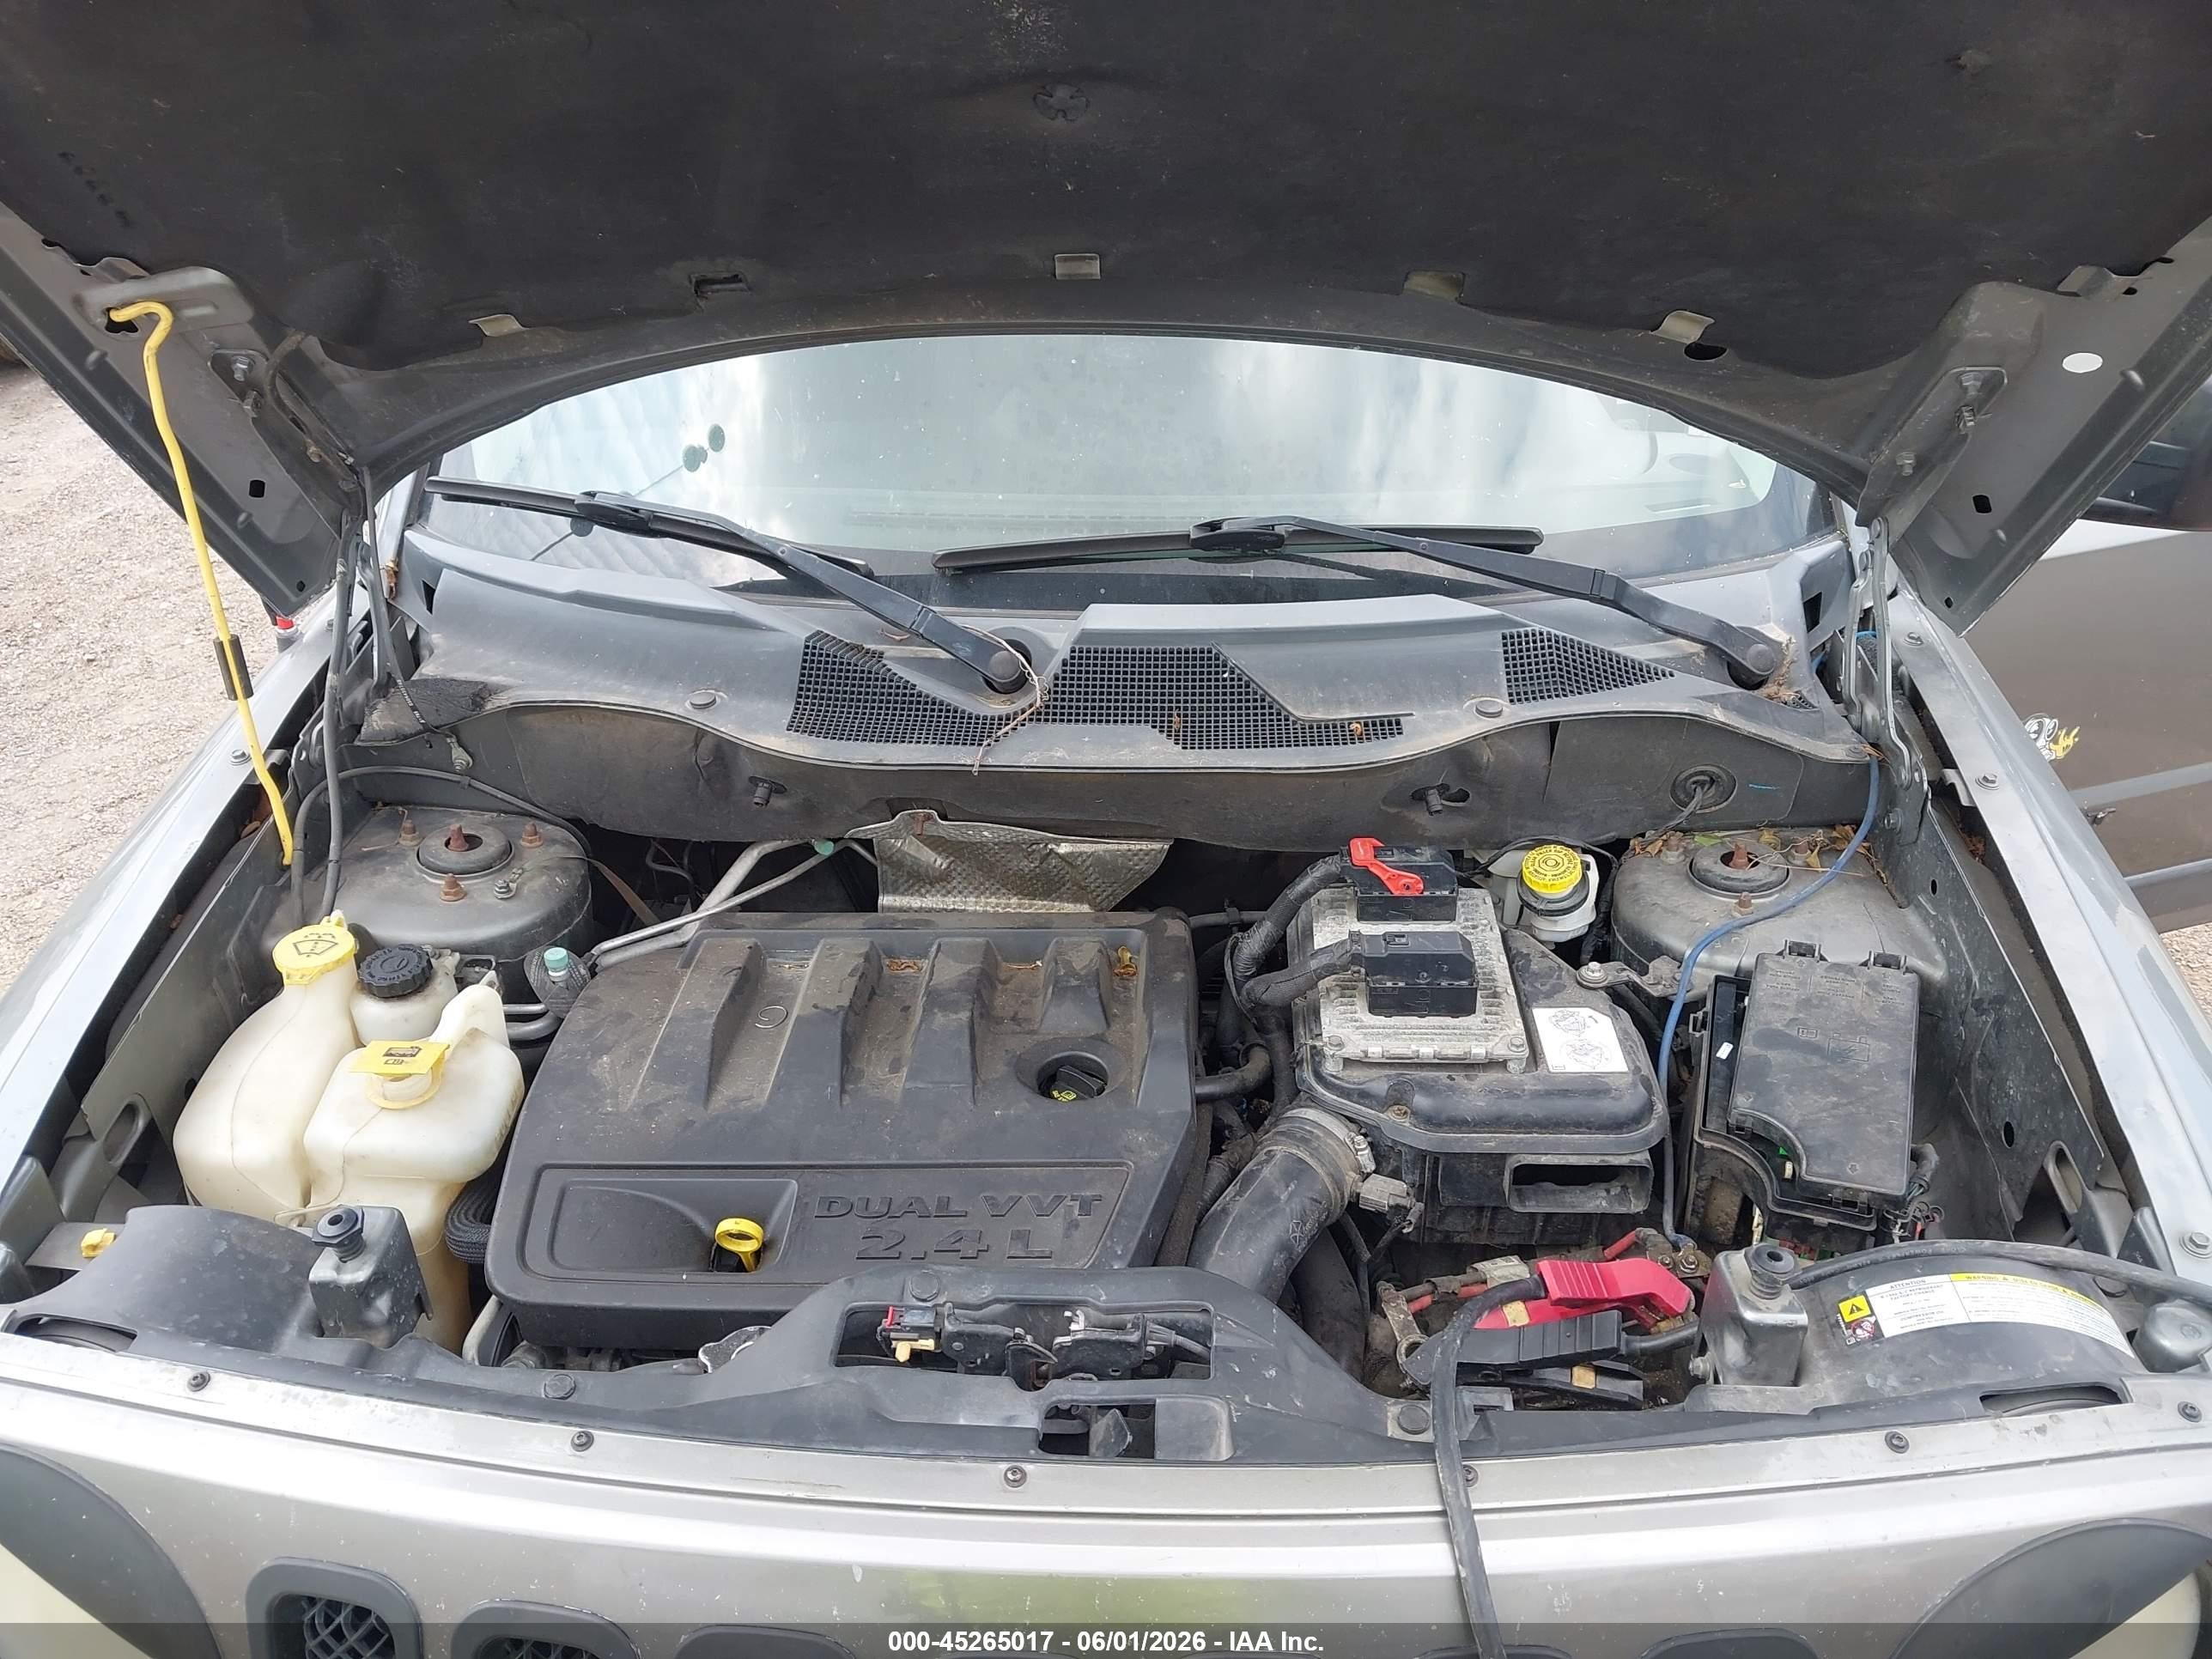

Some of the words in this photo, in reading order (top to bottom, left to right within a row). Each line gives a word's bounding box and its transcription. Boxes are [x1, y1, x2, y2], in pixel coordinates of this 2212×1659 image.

[814, 1195, 968, 1218] DUAL
[981, 1194, 1103, 1218] VVT
[855, 1229, 989, 1260] 2.4
[1006, 1229, 1053, 1260] L
